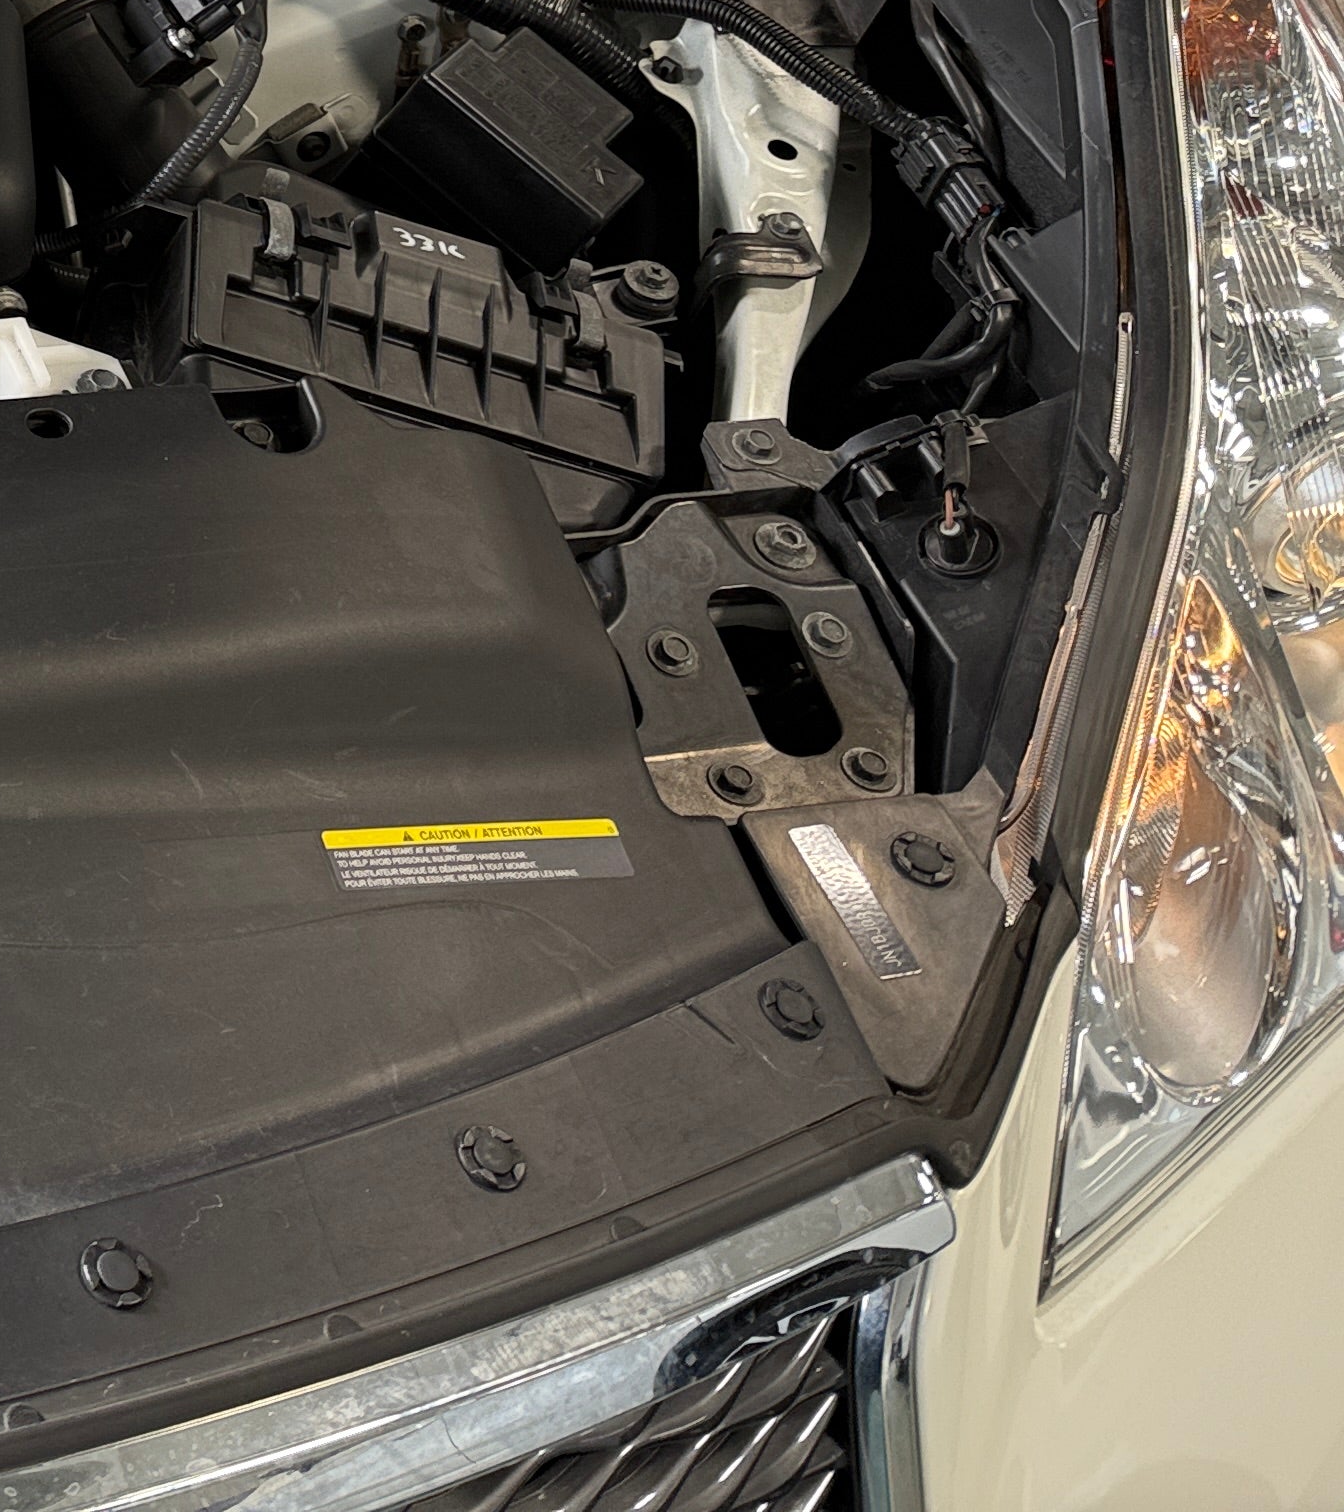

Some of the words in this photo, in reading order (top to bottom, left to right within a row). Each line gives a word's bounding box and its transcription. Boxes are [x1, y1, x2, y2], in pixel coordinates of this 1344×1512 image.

[392, 226, 466, 261] 33K
[419, 828, 471, 841] CAUTION
[482, 826, 544, 838] ATTENTION
[333, 850, 349, 859] FAN
[374, 848, 392, 857] CAN
[337, 859, 349, 868] TO
[475, 851, 501, 861] HANDS
[340, 870, 351, 879] LE
[351, 868, 399, 878] VENTILATEUR
[344, 879, 367, 888] POUR
[392, 876, 417, 885] TOUTE
[469, 872, 484, 881] PAS
[540, 869, 555, 878] LES
